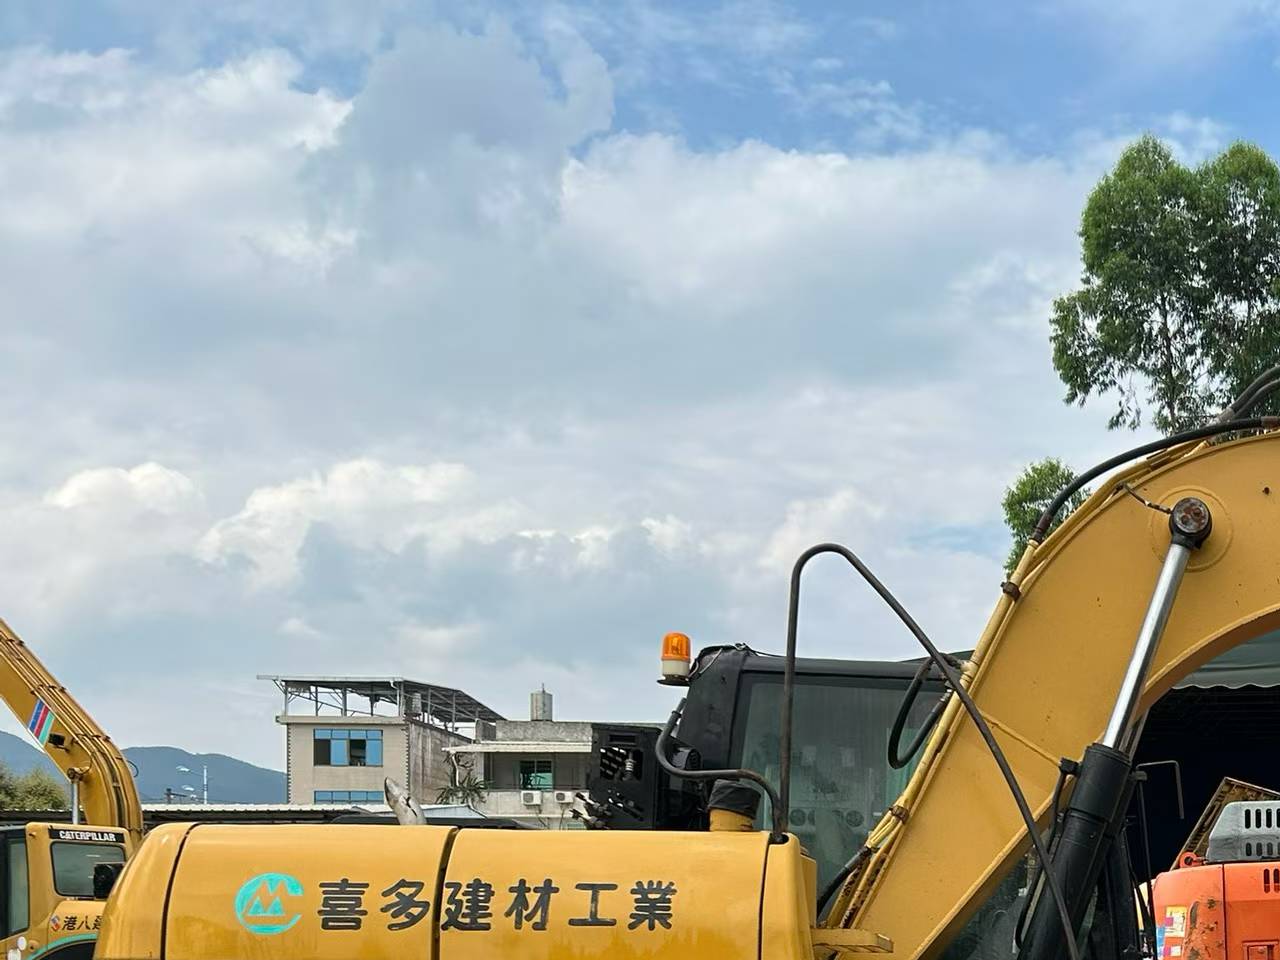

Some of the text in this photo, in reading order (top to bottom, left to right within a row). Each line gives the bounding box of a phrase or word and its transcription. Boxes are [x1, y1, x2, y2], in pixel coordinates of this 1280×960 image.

[59, 830, 117, 842] CATERPILLAR
[317, 877, 678, 932] 喜多建材工業
